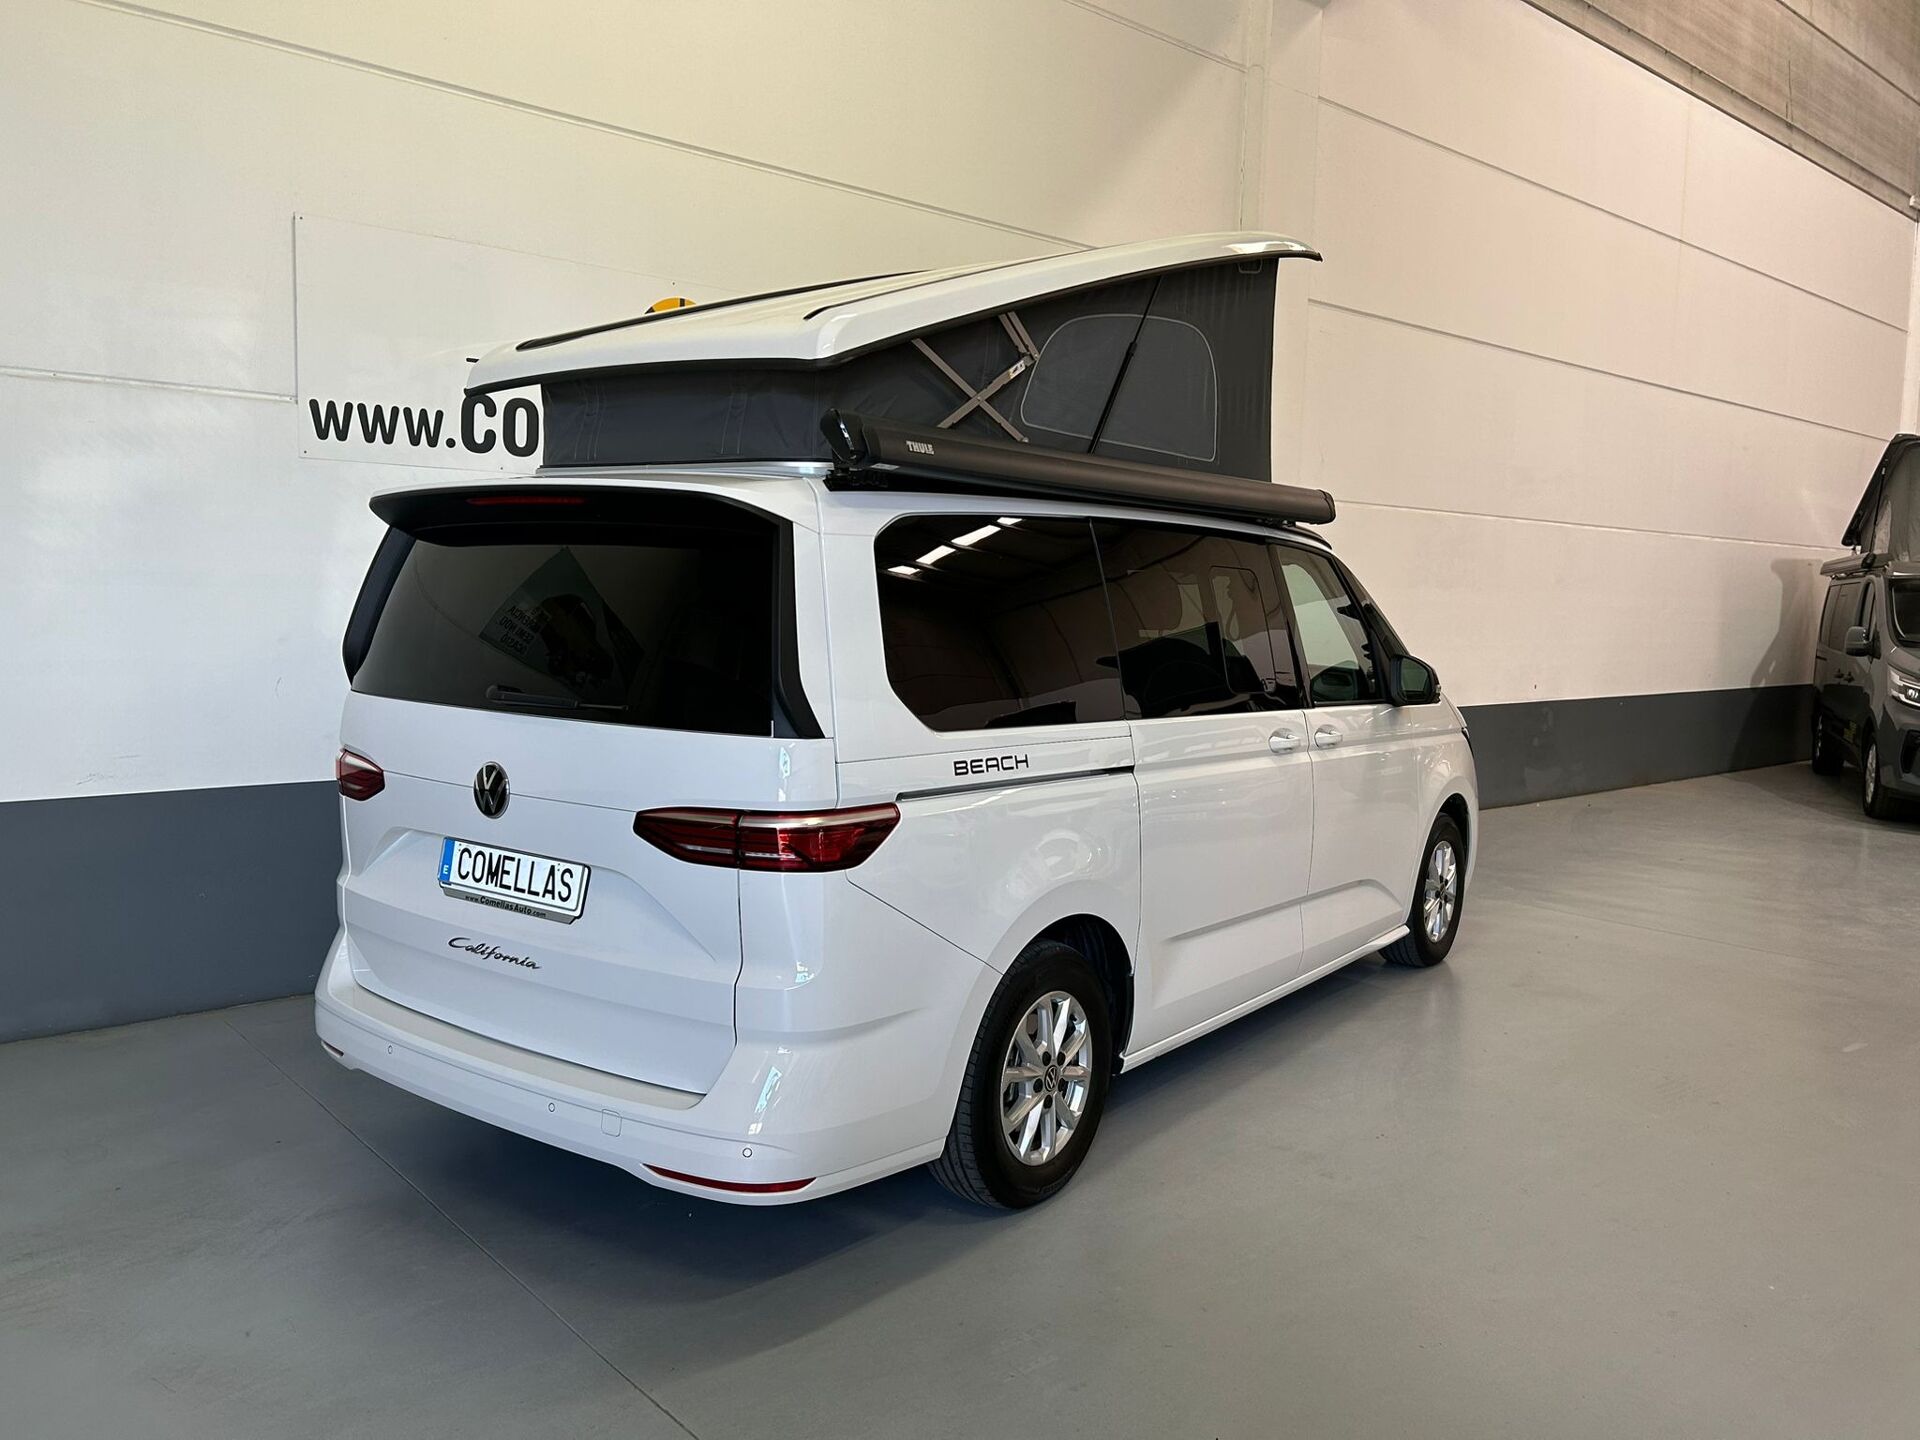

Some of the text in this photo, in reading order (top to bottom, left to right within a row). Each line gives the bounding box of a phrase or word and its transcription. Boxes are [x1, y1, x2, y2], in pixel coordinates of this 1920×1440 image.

[905, 440, 935, 456] THULE
[953, 753, 1030, 777] BEACH
[442, 864, 450, 875] E
[457, 847, 574, 903] COMELLAS
[464, 895, 547, 919] www.ComellasAuto.com
[447, 936, 542, 970] California
